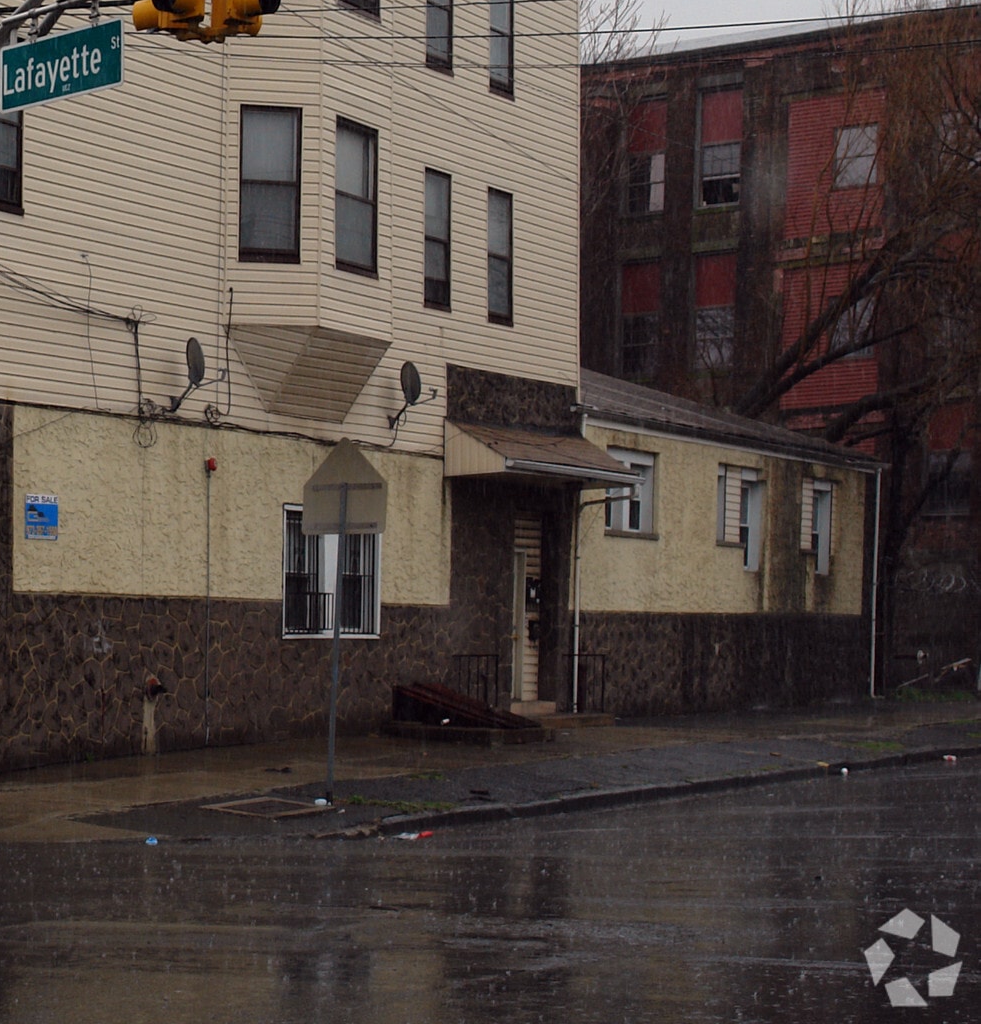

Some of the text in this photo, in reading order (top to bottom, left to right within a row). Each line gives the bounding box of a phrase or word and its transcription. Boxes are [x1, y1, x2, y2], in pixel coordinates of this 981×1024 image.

[3, 35, 120, 95] Lafayette St
[26, 495, 58, 504] FOR SALE
